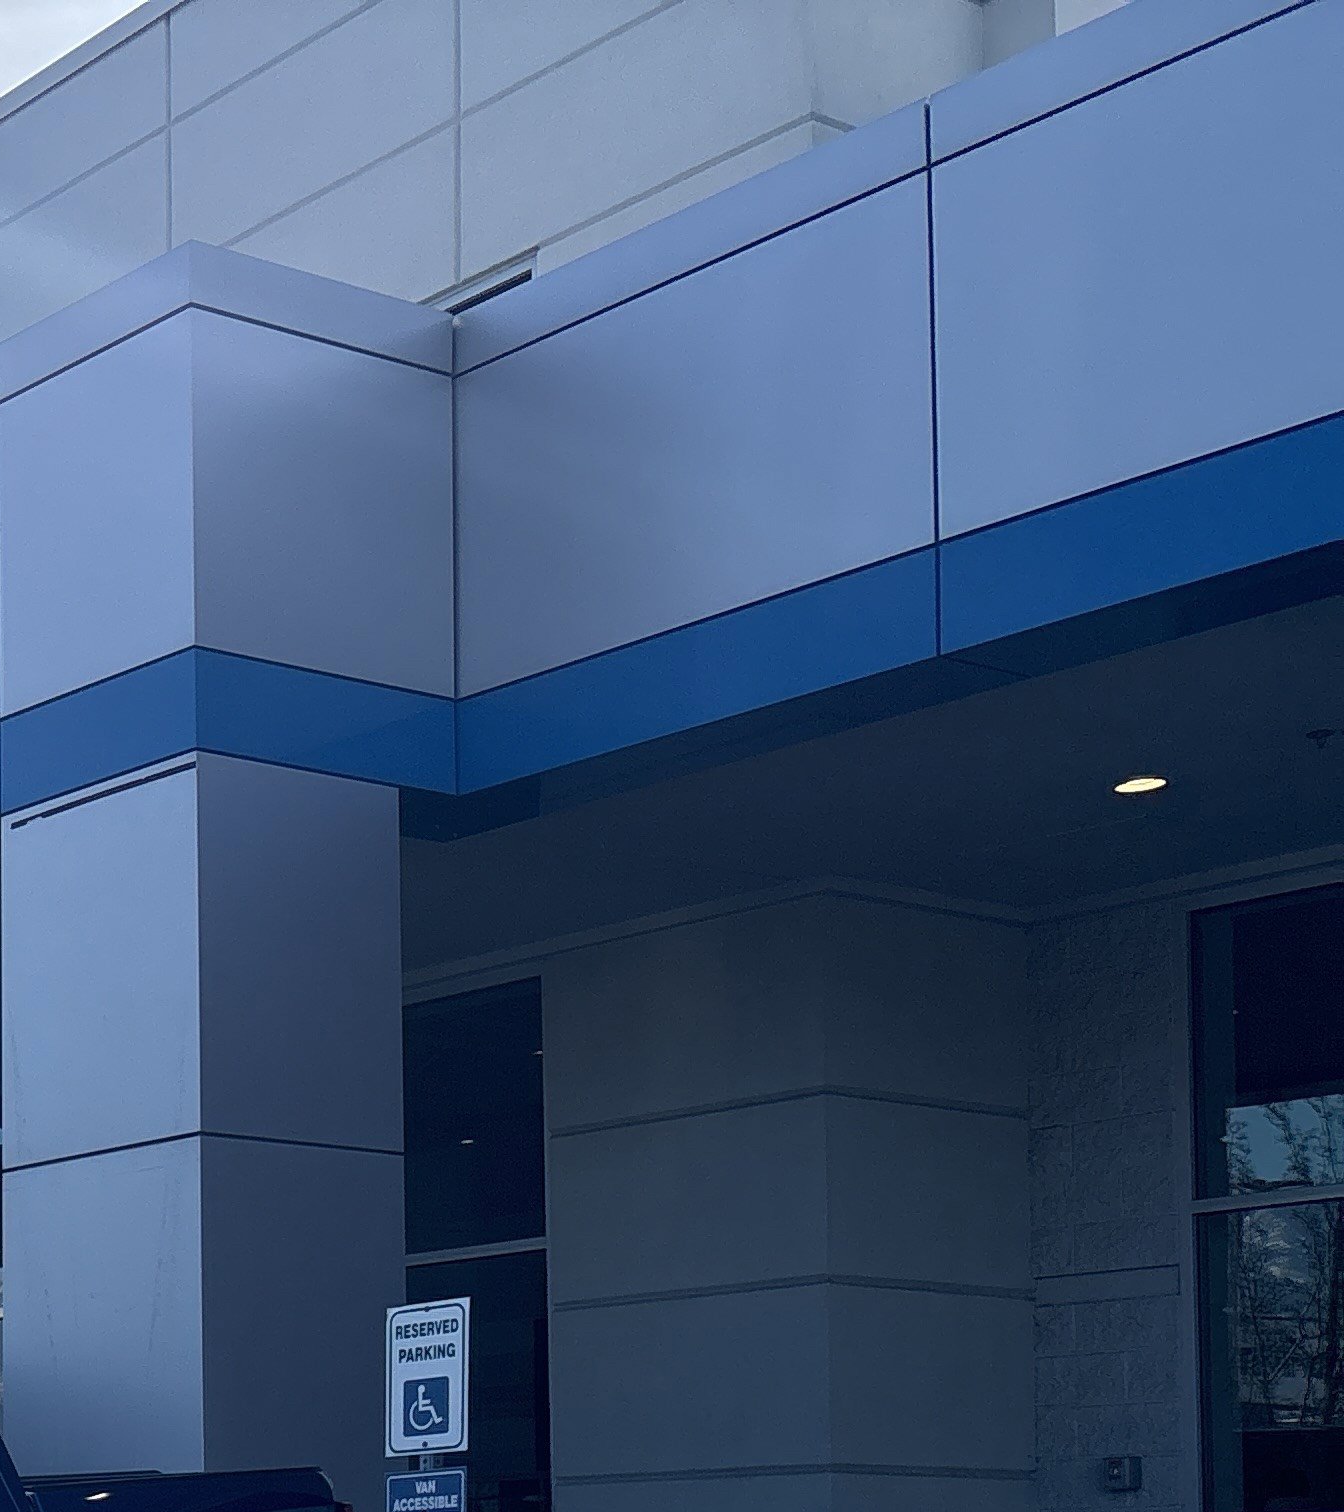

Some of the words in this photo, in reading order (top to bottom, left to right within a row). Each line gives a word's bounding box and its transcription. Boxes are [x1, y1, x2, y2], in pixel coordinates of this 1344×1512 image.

[395, 1318, 459, 1340] RESERVED
[398, 1343, 456, 1364] PARKING
[415, 1479, 436, 1494] VAN
[393, 1494, 458, 1512] ACCESSIBLE
